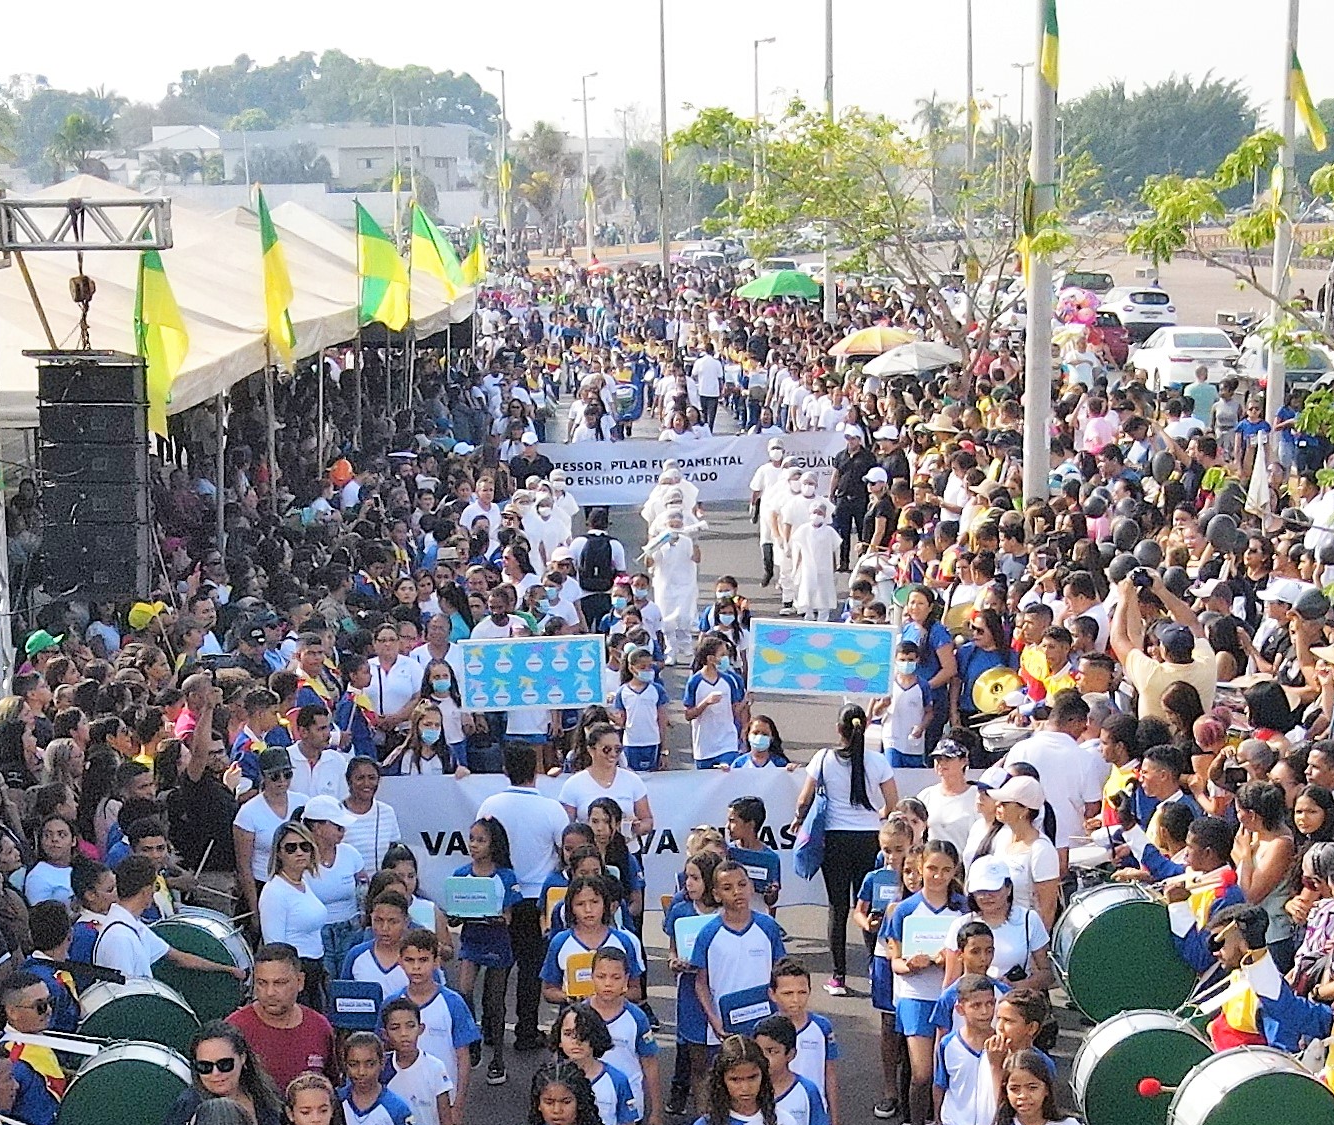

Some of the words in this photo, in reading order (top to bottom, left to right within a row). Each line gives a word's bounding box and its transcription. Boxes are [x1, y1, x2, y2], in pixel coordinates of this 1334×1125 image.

[610, 459, 648, 471] PILAR
[651, 456, 744, 470] FUDAMENTAL
[577, 475, 624, 486] ENSINO
[420, 831, 470, 856] VA
[635, 828, 680, 855] VA
